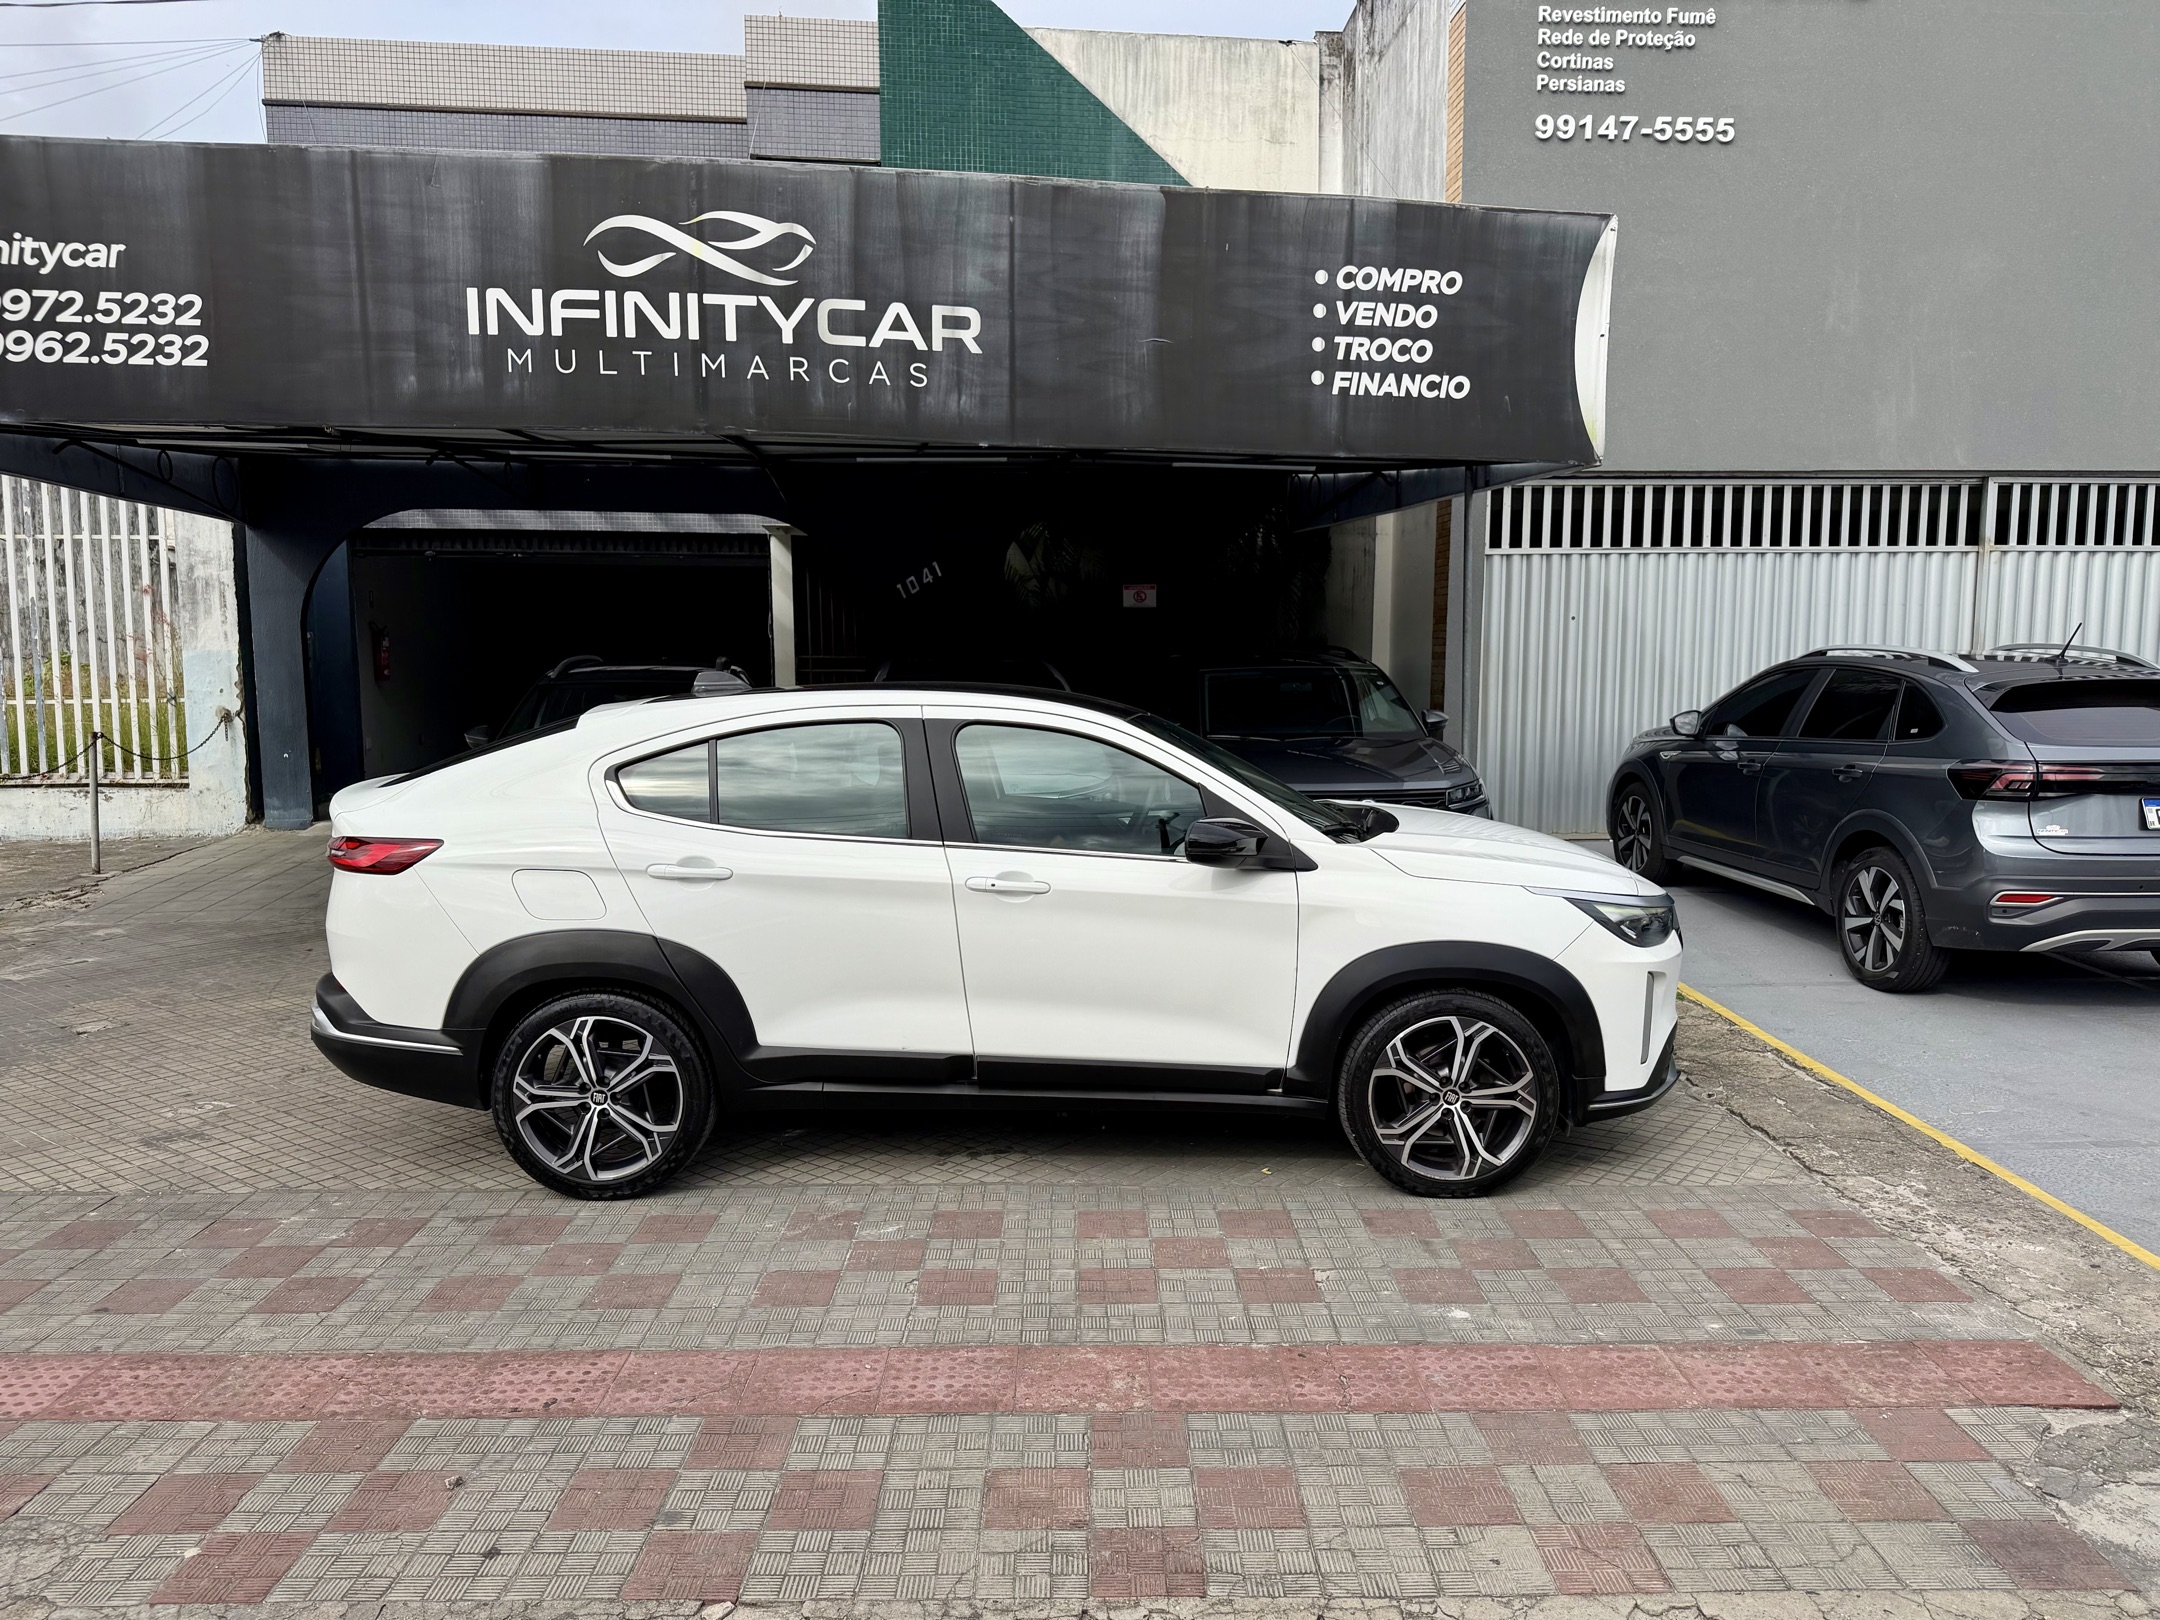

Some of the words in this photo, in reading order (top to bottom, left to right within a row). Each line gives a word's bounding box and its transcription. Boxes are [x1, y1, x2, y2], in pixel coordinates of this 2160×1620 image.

[1538, 6, 1662, 25] Revestimento
[1666, 7, 1717, 26] Fumê
[1537, 29, 1584, 47] Rede
[1588, 29, 1611, 47] de
[1615, 30, 1697, 51] Proteção
[1536, 51, 1615, 70] Cortinas
[1536, 75, 1626, 93] Persianas
[1534, 114, 1736, 143] 99147-5555
[1336, 265, 1463, 295] COMPRO
[0, 288, 203, 326] 972.5232
[466, 287, 983, 354] INFINITYCAR
[1335, 300, 1438, 329] VENDO
[0, 329, 210, 367] 962.5232
[1333, 336, 1434, 363] TROCO
[507, 348, 929, 388] MULTIMARCAS
[1331, 371, 1471, 400] FINANCIO
[896, 561, 942, 599] 1041
[592, 1092, 606, 1104] FIAT
[1444, 1091, 1459, 1104] FIAT
